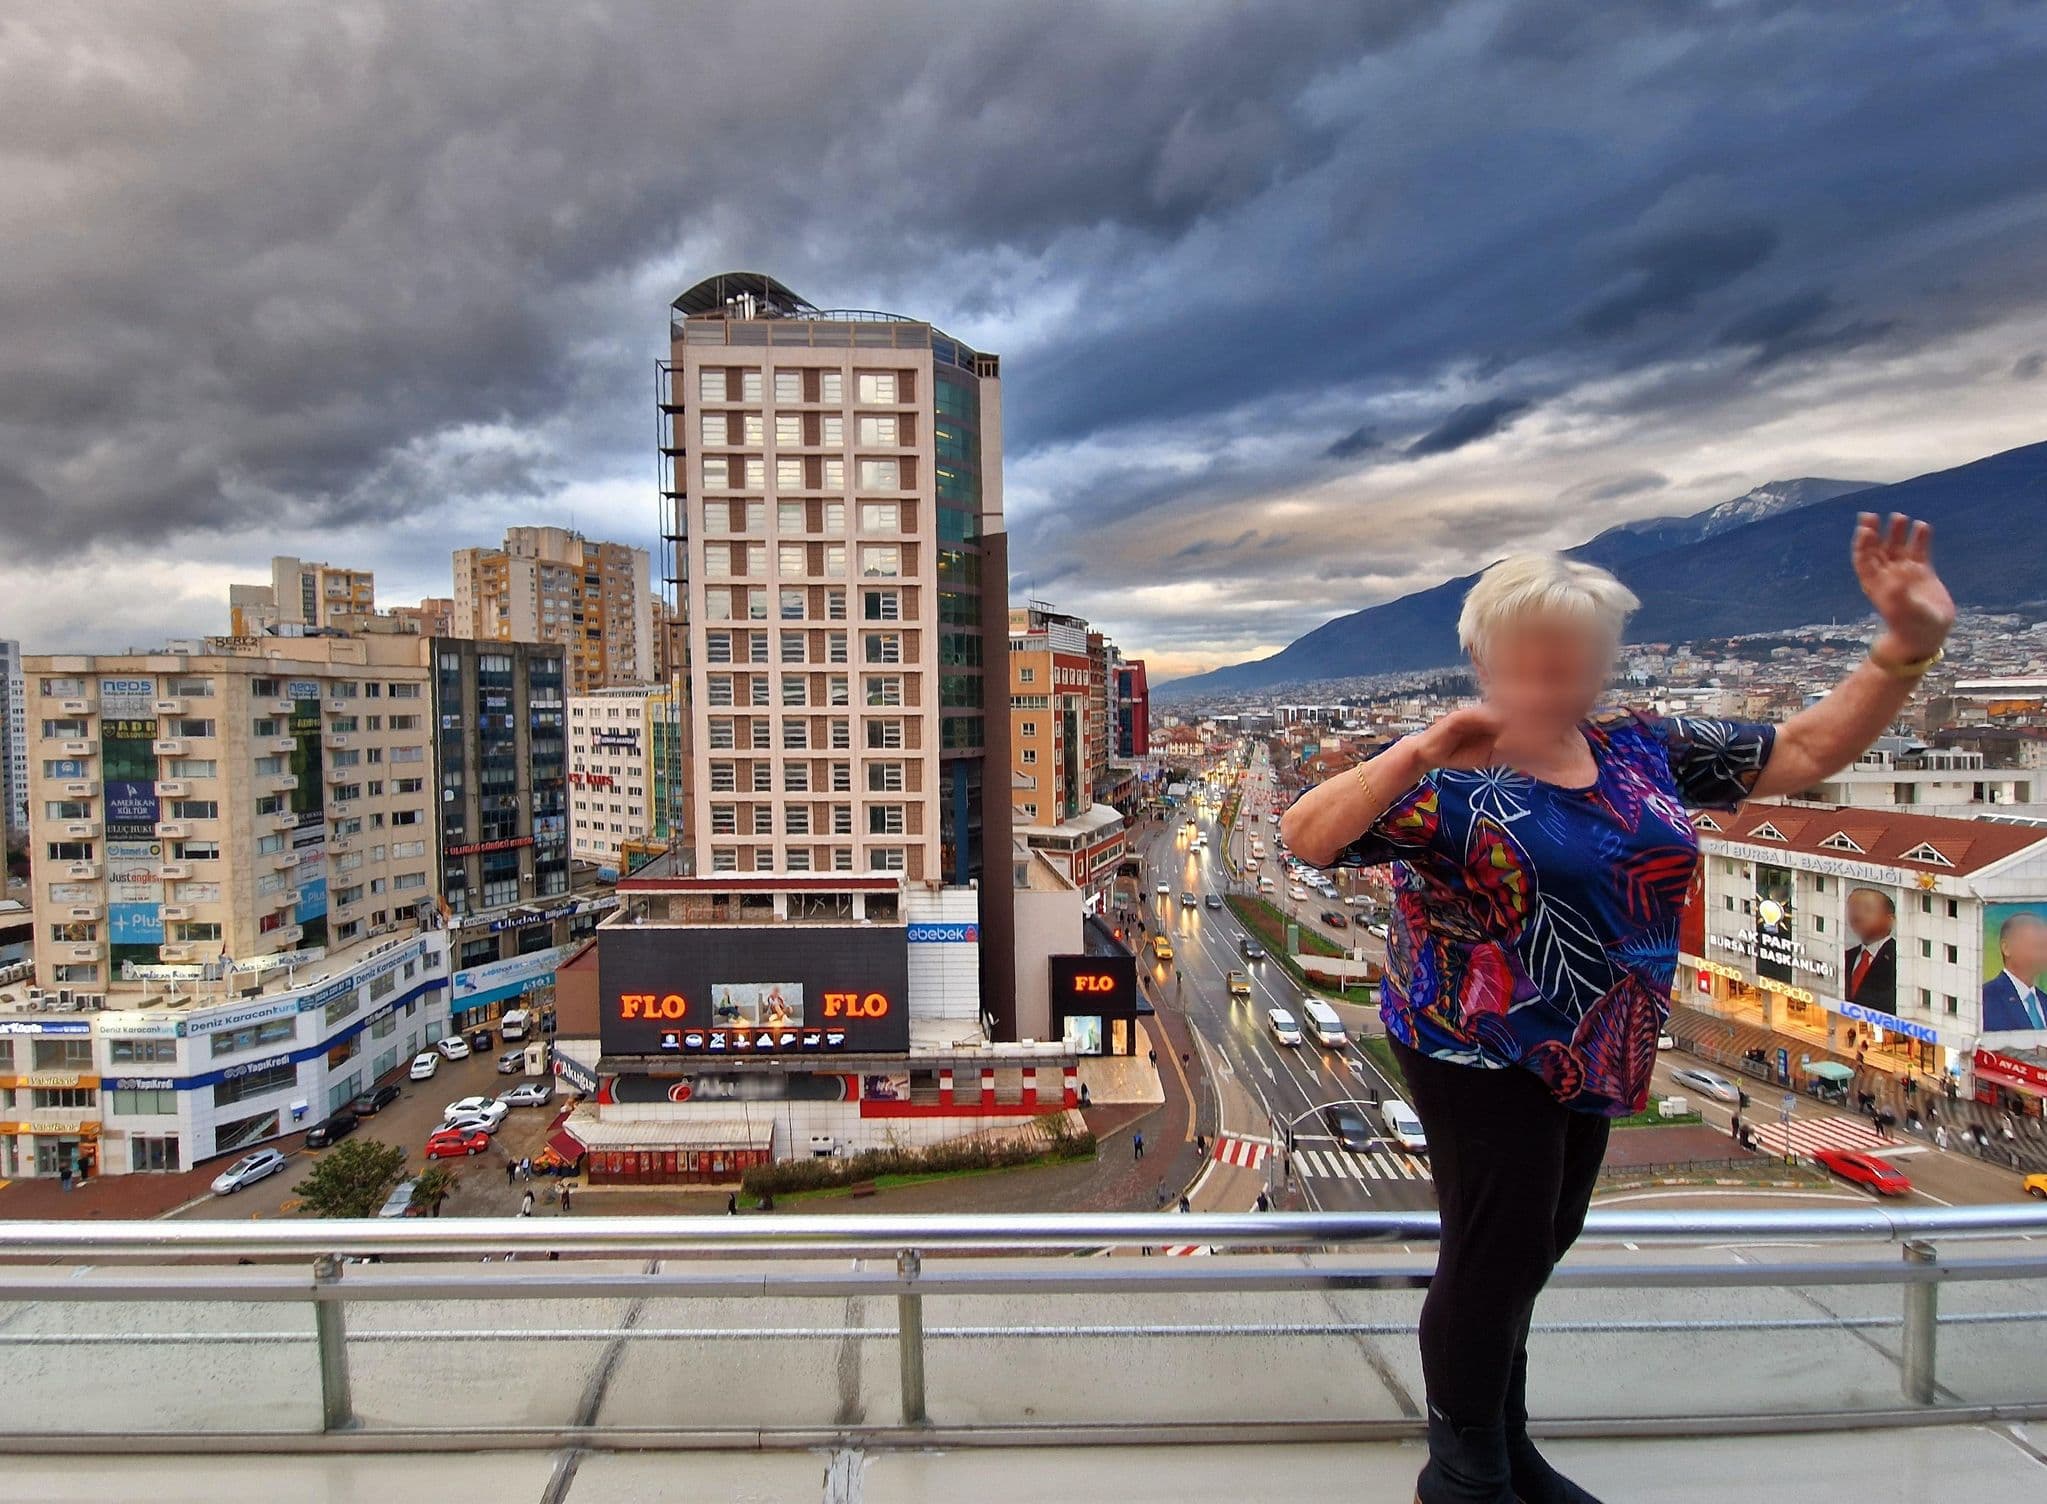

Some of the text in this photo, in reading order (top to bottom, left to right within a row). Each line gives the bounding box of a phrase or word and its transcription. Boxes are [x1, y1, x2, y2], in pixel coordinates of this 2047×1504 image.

[132, 913, 163, 927] Plus
[908, 927, 965, 941] ebebek
[1737, 928, 1806, 955] AK PARTİ
[1709, 934, 1746, 955] BURSA
[1759, 947, 1834, 977] BAŞKANLIĞI
[1074, 975, 1115, 991] FLO
[620, 993, 687, 1019] FLO
[823, 992, 889, 1018] FLO
[1839, 1002, 1862, 1020] LC
[190, 1018, 223, 1033] Deniz
[1999, 1060, 2028, 1076] AYAZ
